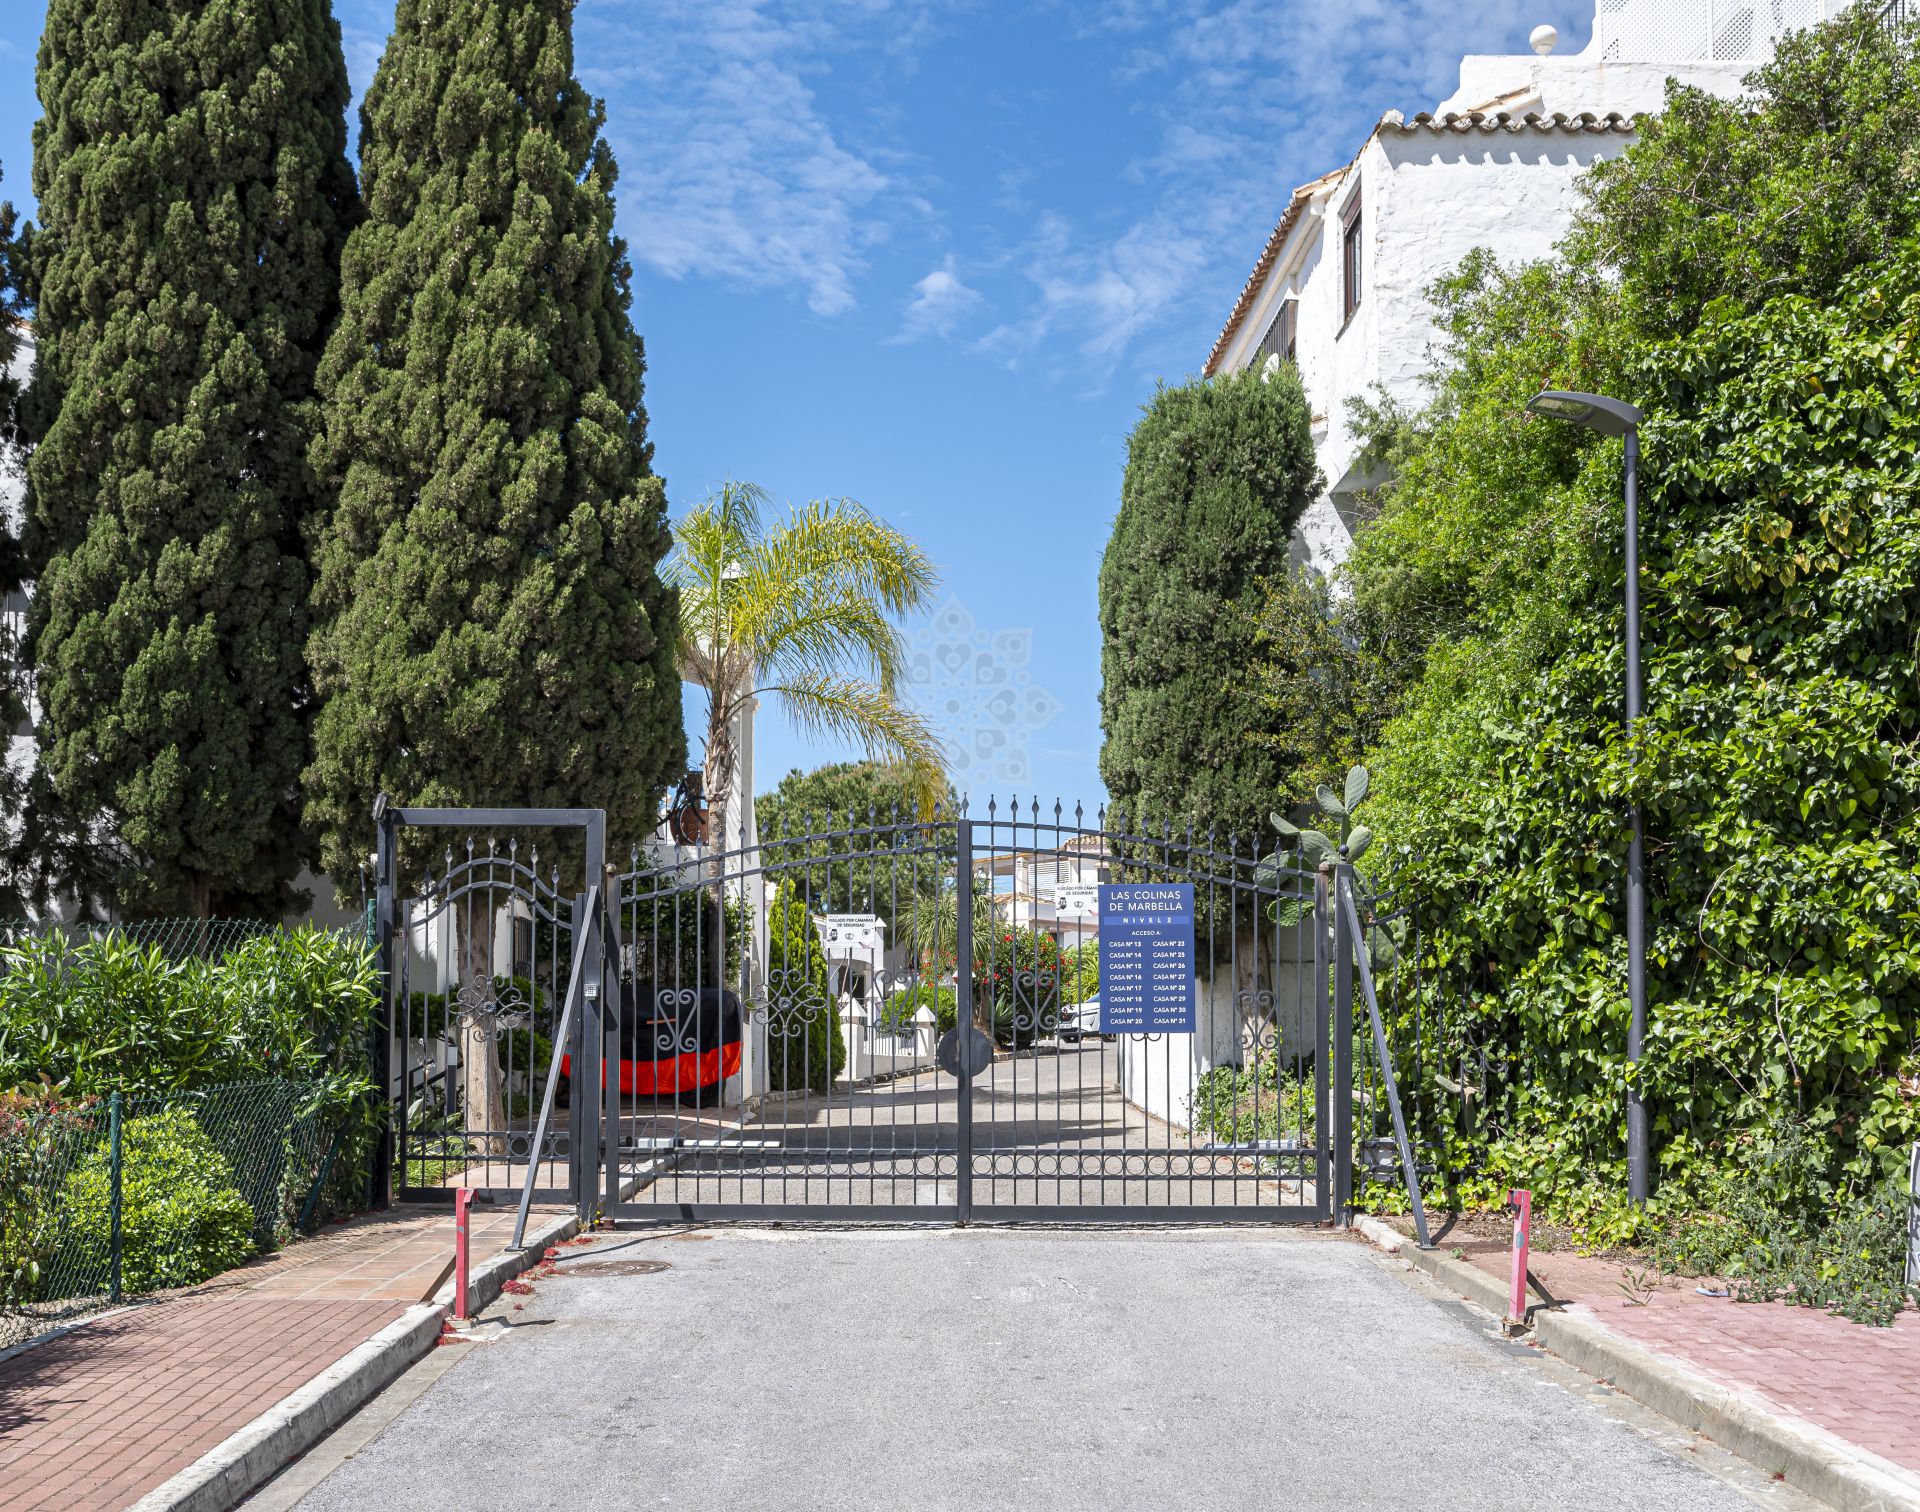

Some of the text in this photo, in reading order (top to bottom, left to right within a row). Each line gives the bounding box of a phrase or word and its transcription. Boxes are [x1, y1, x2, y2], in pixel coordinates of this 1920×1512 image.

[1111, 891, 1180, 900] LAS COLINAS
[1110, 902, 1182, 911] DE MARBELLA
